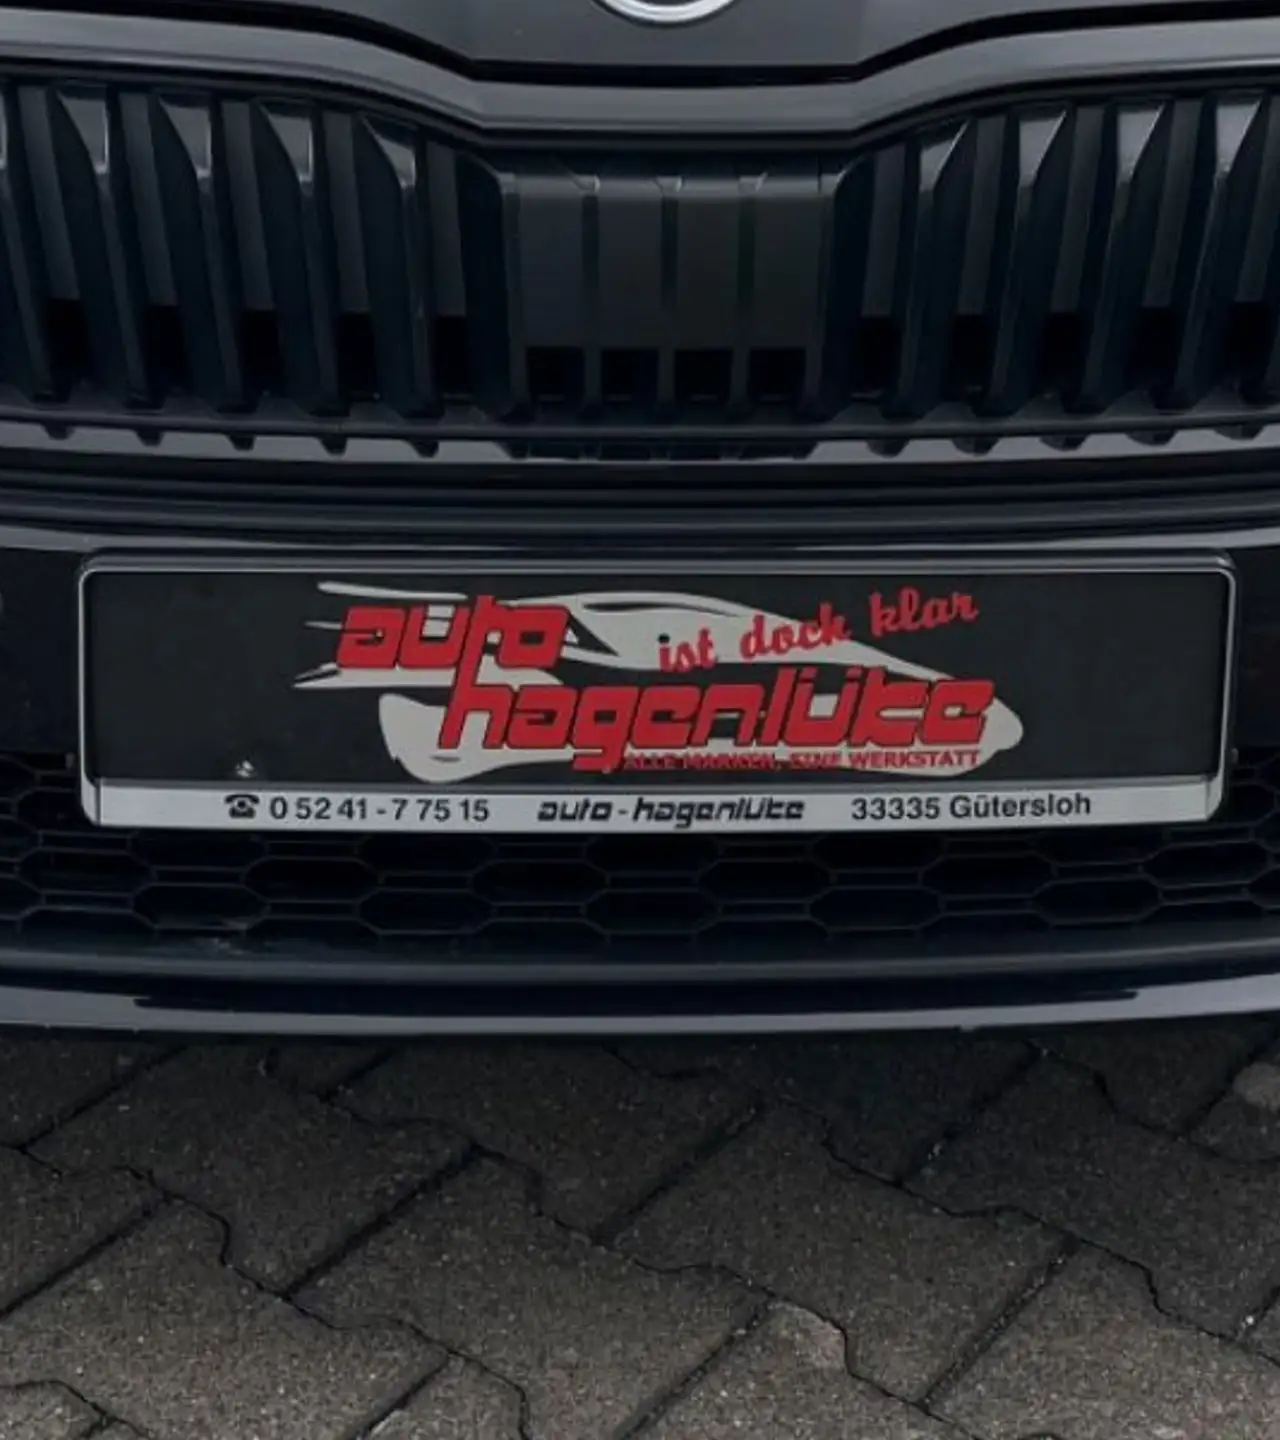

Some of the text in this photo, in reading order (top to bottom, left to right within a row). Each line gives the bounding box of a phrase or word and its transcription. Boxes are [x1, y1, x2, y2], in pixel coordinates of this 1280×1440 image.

[335, 595, 570, 671] auto
[658, 585, 979, 673] ist doch klar
[847, 748, 981, 767] WERKSTATT
[851, 792, 1091, 820] 33335 Gütersloh
